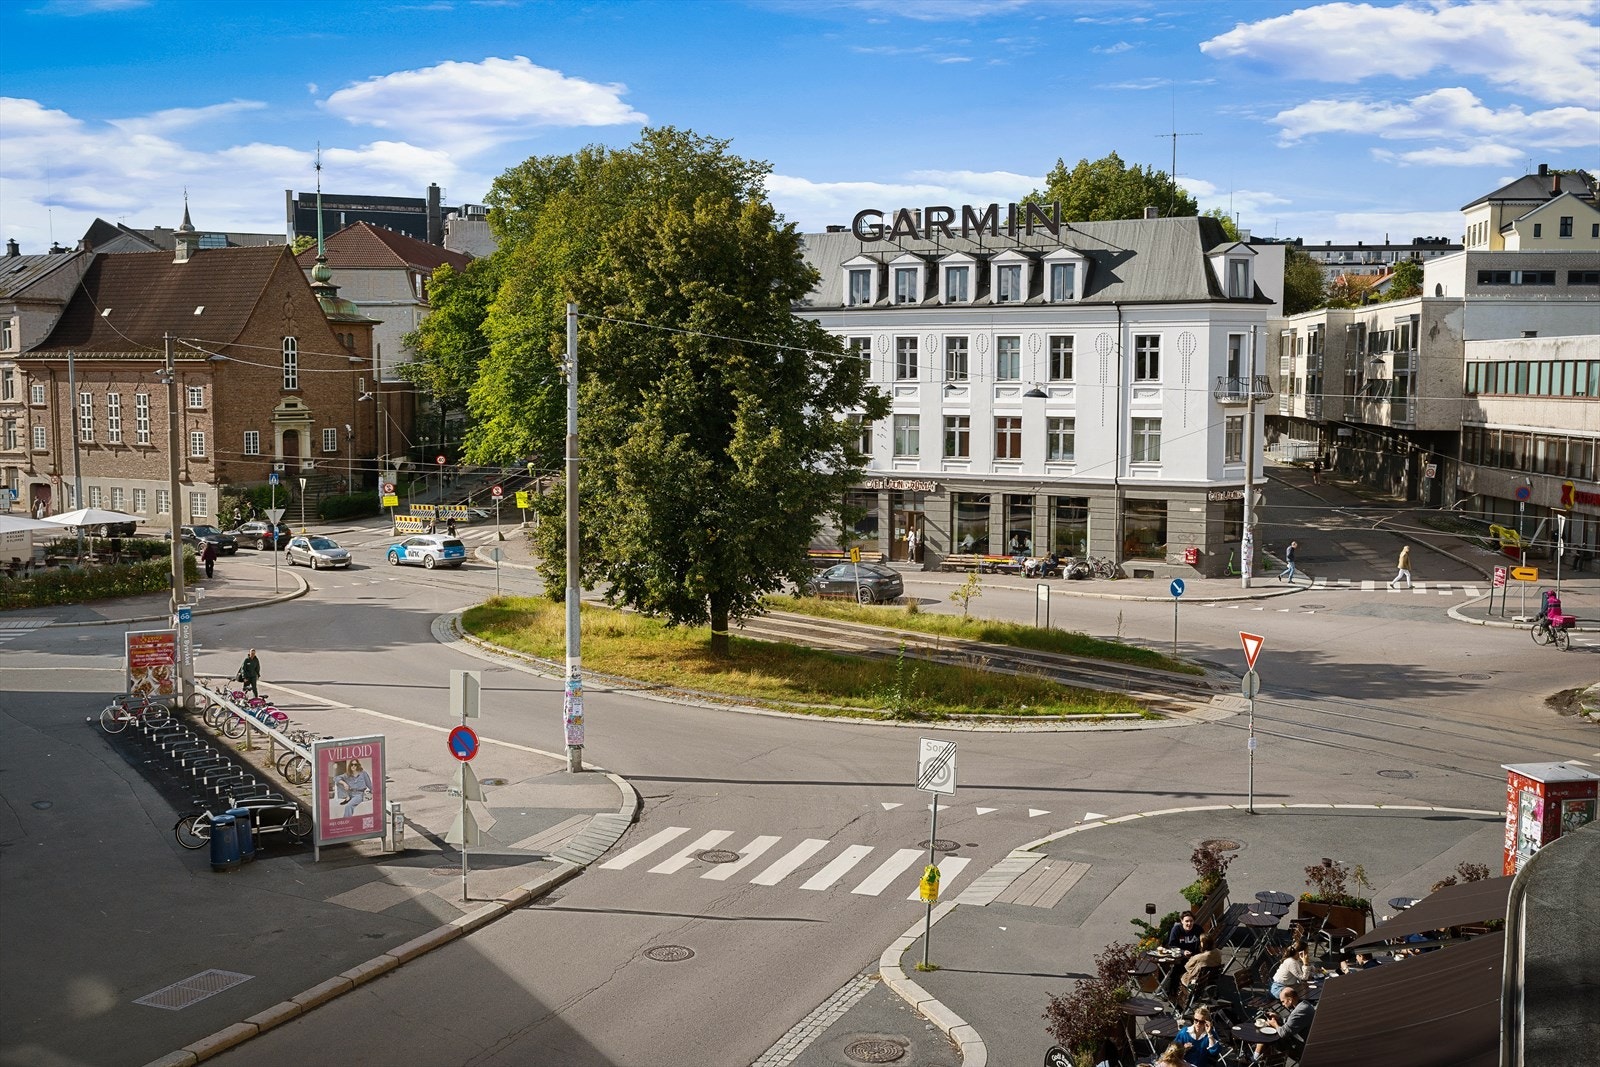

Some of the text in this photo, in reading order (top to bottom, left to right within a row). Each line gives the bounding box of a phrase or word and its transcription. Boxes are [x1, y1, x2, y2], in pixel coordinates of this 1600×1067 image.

[851, 201, 1062, 242] GARMIN
[183, 639, 191, 666] Bysykkel
[328, 744, 373, 760] VILLOID
[1179, 935, 1198, 944] FILA
